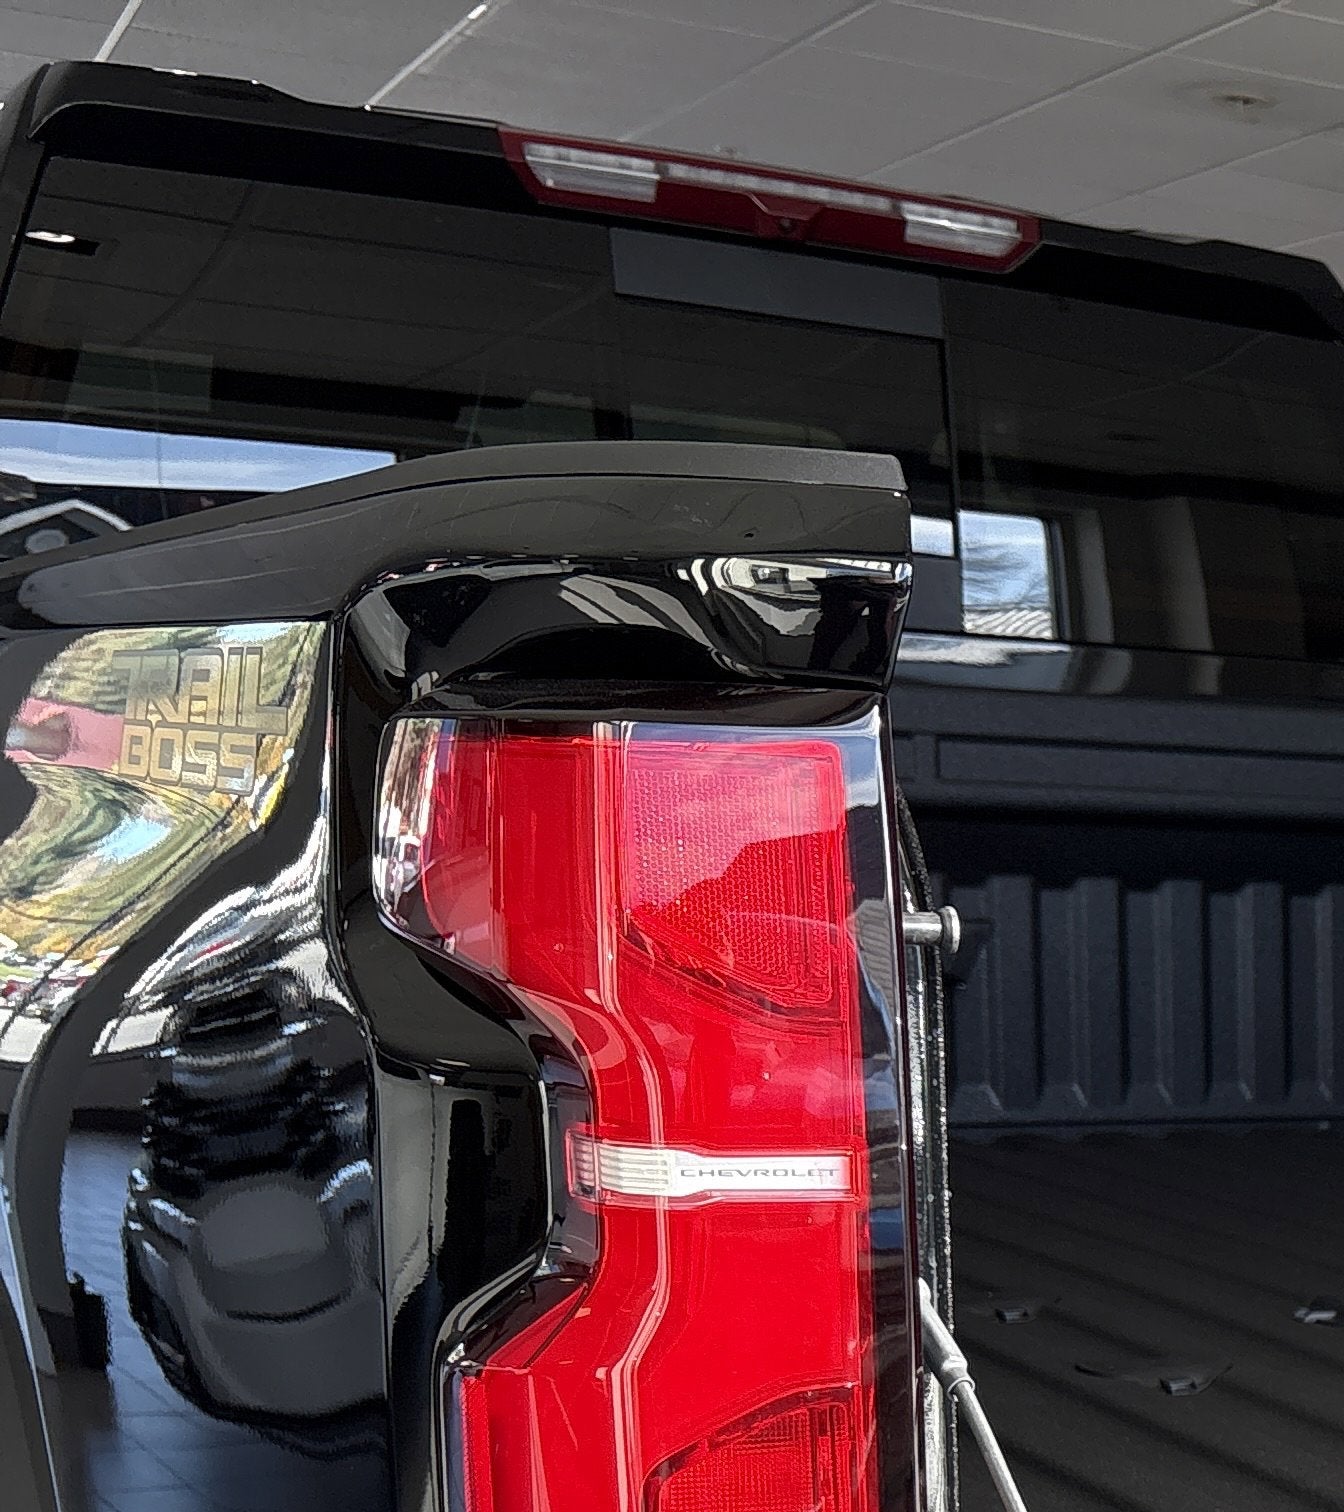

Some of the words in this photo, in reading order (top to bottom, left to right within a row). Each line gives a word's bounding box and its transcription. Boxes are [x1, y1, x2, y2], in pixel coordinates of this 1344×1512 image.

[112, 647, 288, 735] TRAIL
[119, 720, 257, 796] BOSS
[679, 1167, 841, 1178] CHEVROLET
